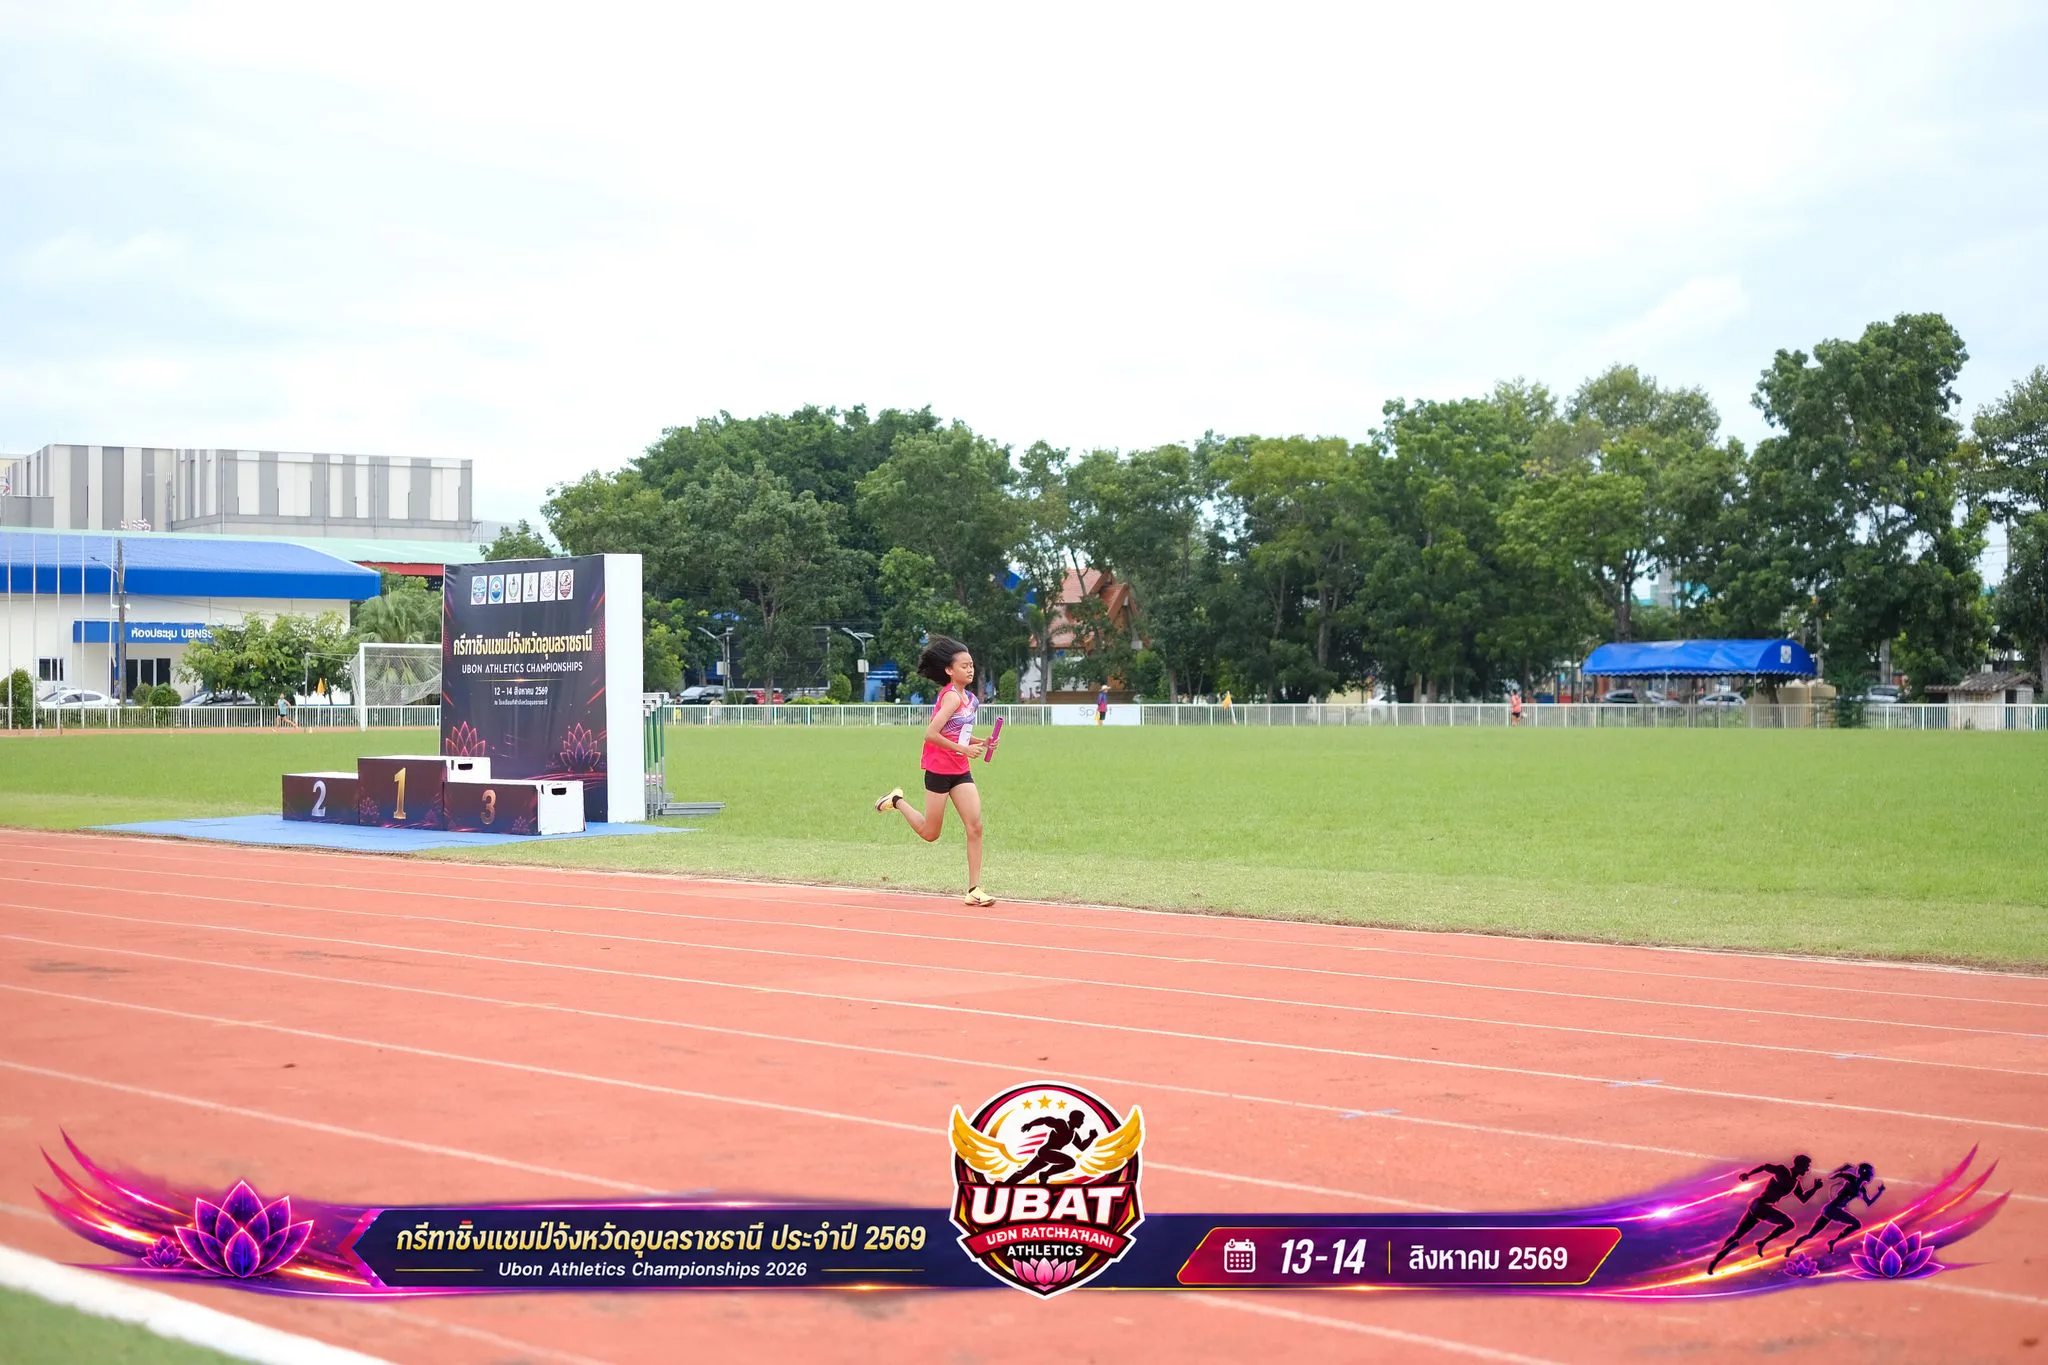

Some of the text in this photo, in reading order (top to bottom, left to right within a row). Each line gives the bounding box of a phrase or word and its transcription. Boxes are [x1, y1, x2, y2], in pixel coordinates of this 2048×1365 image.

[131, 627, 178, 640] ห้องประชุม
[461, 661, 583, 674] UBON ATHLETICS CHAMPIONSHIPS
[494, 686, 500, 696] 12
[506, 686, 512, 696] 14
[535, 686, 548, 696] 2569
[1079, 706, 1113, 719] Spt
[312, 780, 327, 817] 2
[393, 767, 407, 820] 1
[480, 789, 496, 825] 3
